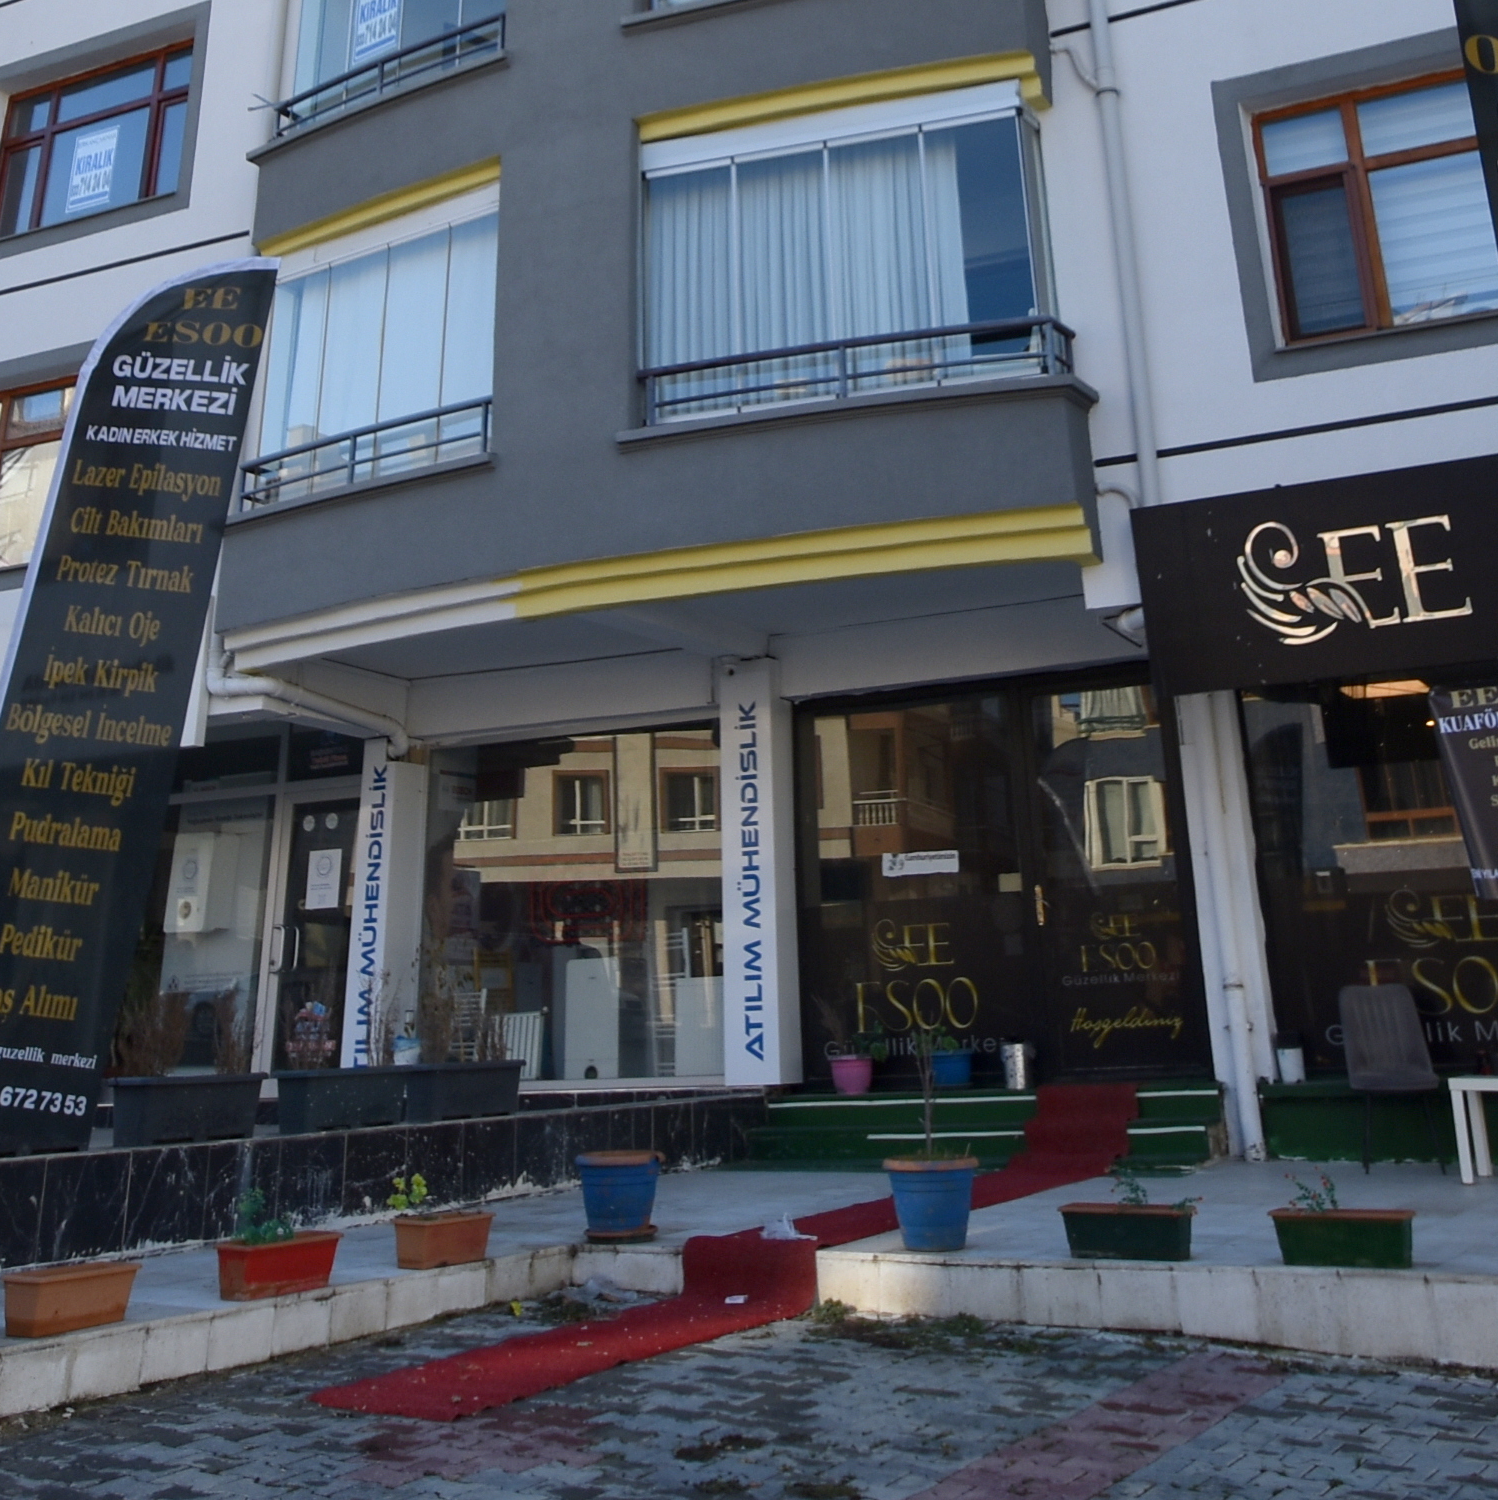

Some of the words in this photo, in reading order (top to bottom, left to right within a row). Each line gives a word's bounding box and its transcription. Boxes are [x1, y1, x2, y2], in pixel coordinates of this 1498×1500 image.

[75, 148, 114, 176] KİRALIK
[182, 286, 241, 310] EE
[143, 321, 263, 348] ESOO
[112, 351, 249, 385] GÜZELLİK
[111, 385, 238, 415] MERKEZİ
[86, 425, 133, 444] KADIN
[133, 428, 180, 447] ERKEK
[180, 428, 237, 451] HİZMET
[72, 459, 126, 488] Lazer
[128, 463, 221, 502] Epilasyon
[70, 506, 102, 535] Cilt
[105, 510, 203, 543] Bakımları
[56, 555, 119, 585] Protez
[127, 560, 194, 593] Tırnak
[1317, 514, 1473, 629] EE
[63, 605, 123, 637] Kalıcı
[129, 611, 161, 647] Oje
[43, 646, 88, 689] İpek
[94, 659, 159, 697] Kirpik
[5, 703, 92, 744] Bölgesel
[95, 704, 172, 747] İncelme
[21, 758, 54, 788] Kıl
[61, 762, 136, 806] Tekniği
[8, 811, 121, 851] Pudralama
[734, 701, 762, 929] MÜHENDİSLİK
[8, 867, 99, 906] Manikür
[357, 764, 388, 978] MÜHENDİSLİK
[19, 985, 78, 1021] Alımı
[743, 939, 765, 1062] ATILIM
[353, 987, 374, 1068] TILIM
[51, 1053, 97, 1070] merkezi
[0, 1085, 38, 1109] 672
[39, 1091, 62, 1113] 73
[63, 1095, 87, 1116] 53
